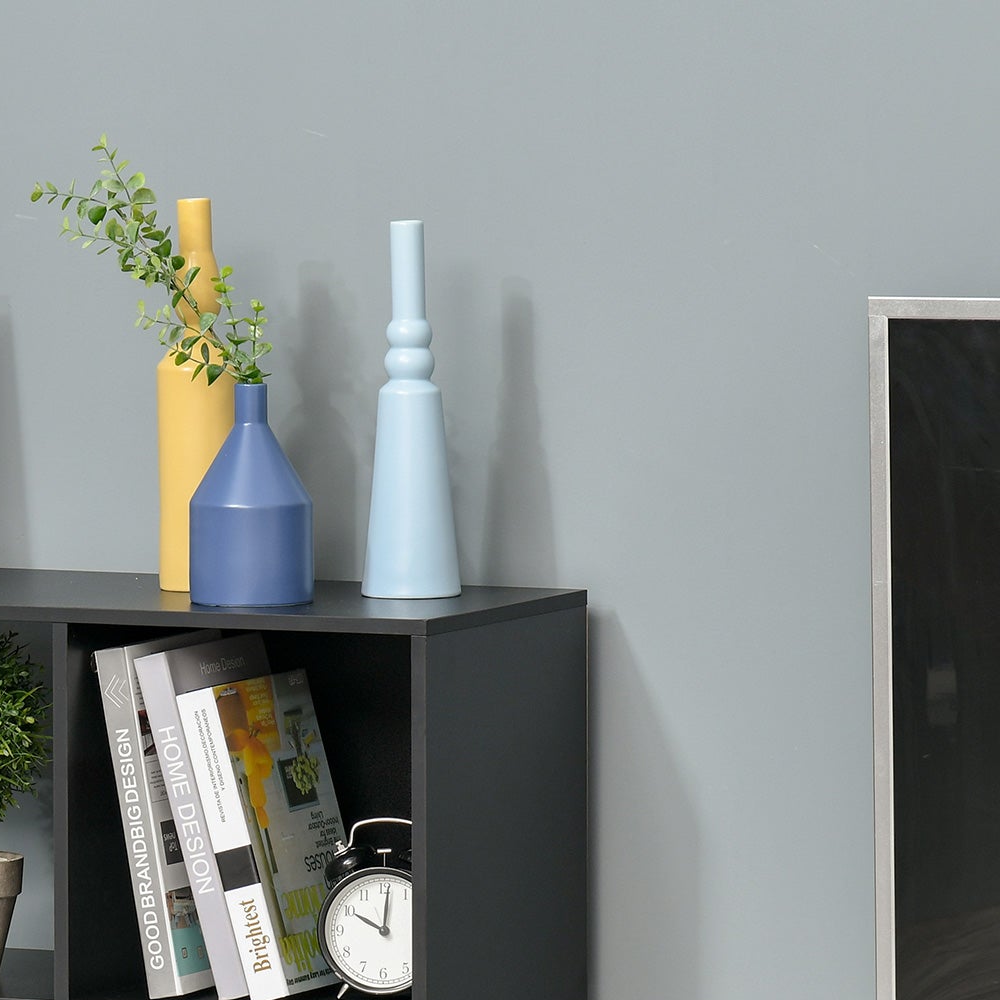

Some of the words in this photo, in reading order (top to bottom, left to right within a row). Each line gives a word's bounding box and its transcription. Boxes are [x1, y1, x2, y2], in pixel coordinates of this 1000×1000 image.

[200, 661, 221, 675] Home
[158, 726, 190, 798] HOME
[217, 798, 226, 823] REVISTA
[360, 889, 368, 901] 11
[379, 882, 391, 895] 12
[344, 905, 355, 917] 10
[240, 898, 271, 974] Brightest
[336, 924, 344, 937] 9
[342, 945, 351, 958] 8
[359, 961, 367, 973] 7
[379, 968, 387, 979] 6
[402, 962, 410, 974] 5
